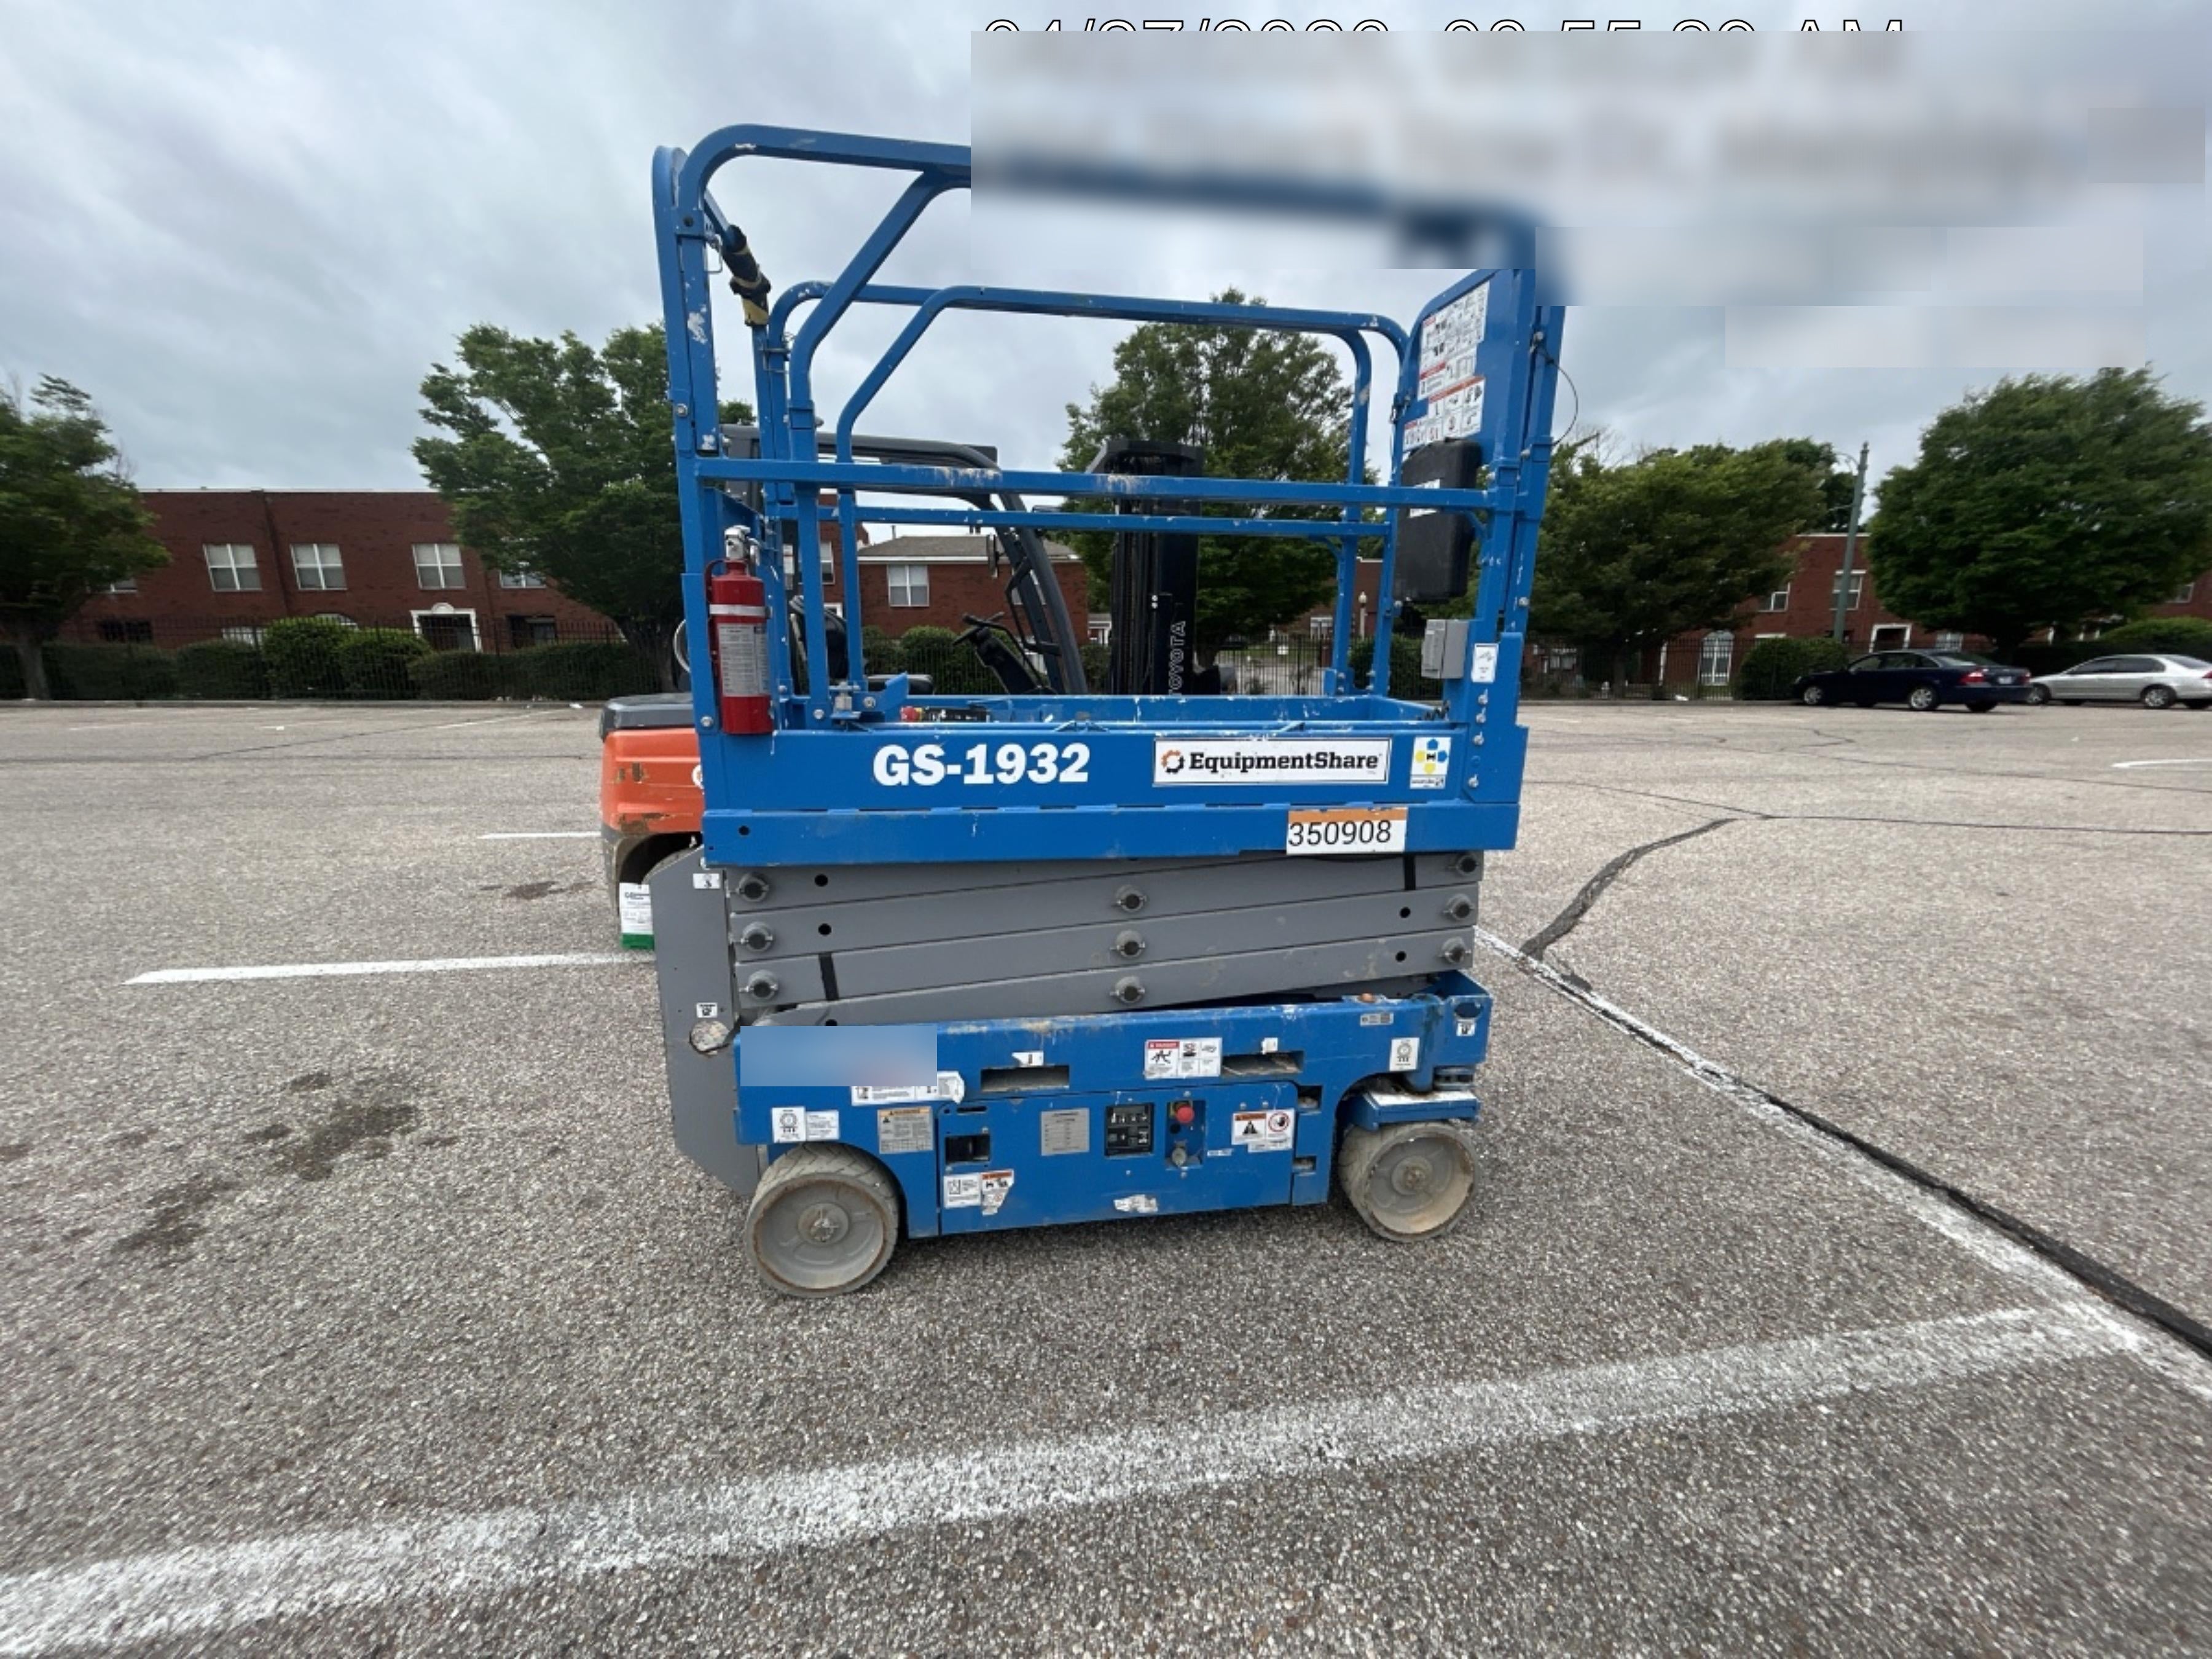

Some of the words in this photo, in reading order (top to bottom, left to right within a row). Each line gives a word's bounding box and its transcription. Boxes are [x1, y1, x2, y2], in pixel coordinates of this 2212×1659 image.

[873, 742, 1091, 786] GS-1932
[1189, 751, 1379, 774] EquipmentShare
[1288, 820, 1392, 846] 350908
